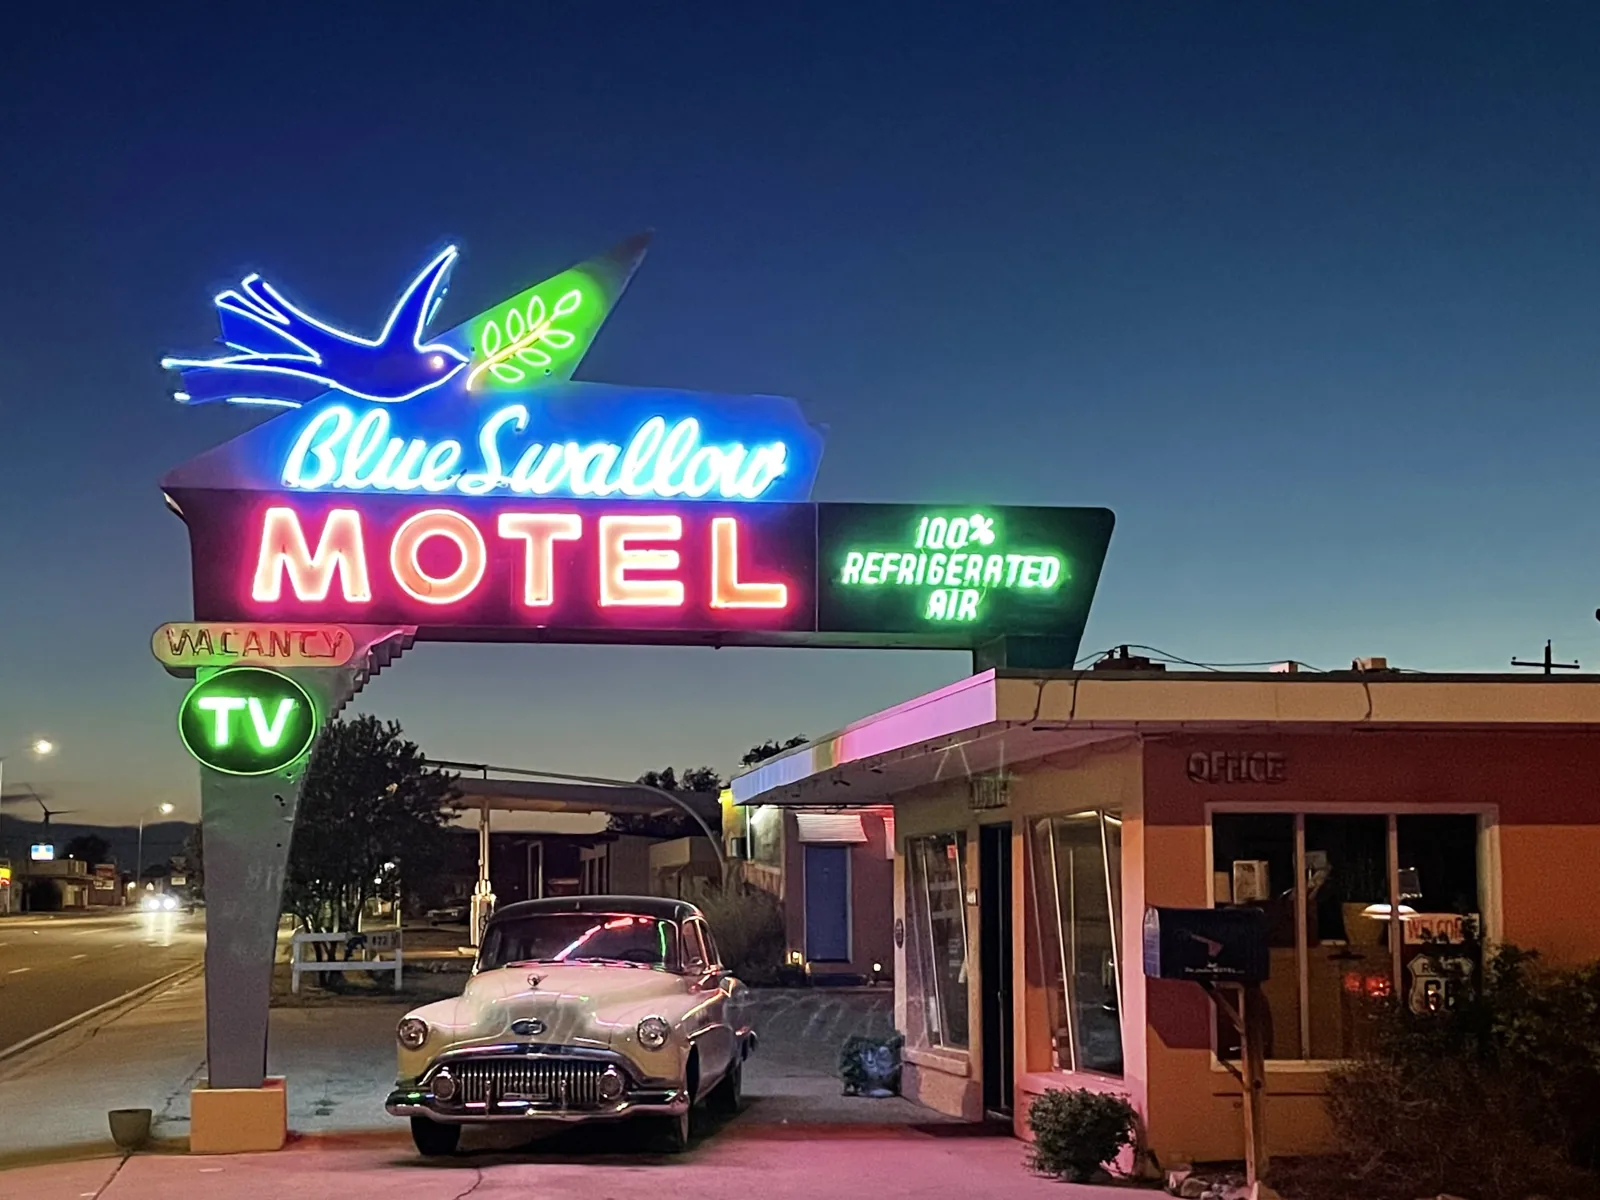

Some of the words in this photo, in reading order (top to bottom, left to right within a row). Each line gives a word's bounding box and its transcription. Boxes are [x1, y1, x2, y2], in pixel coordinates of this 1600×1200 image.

[281, 404, 465, 492] Blue
[459, 404, 788, 498] Swallow
[914, 513, 996, 549] 100%
[251, 506, 789, 609] MOTEL
[841, 551, 1062, 589] REFRIGERATED
[925, 588, 980, 622] AIR
[166, 627, 344, 658] VACANCY
[198, 696, 296, 748] TV
[1187, 751, 1287, 784] OFFICE
